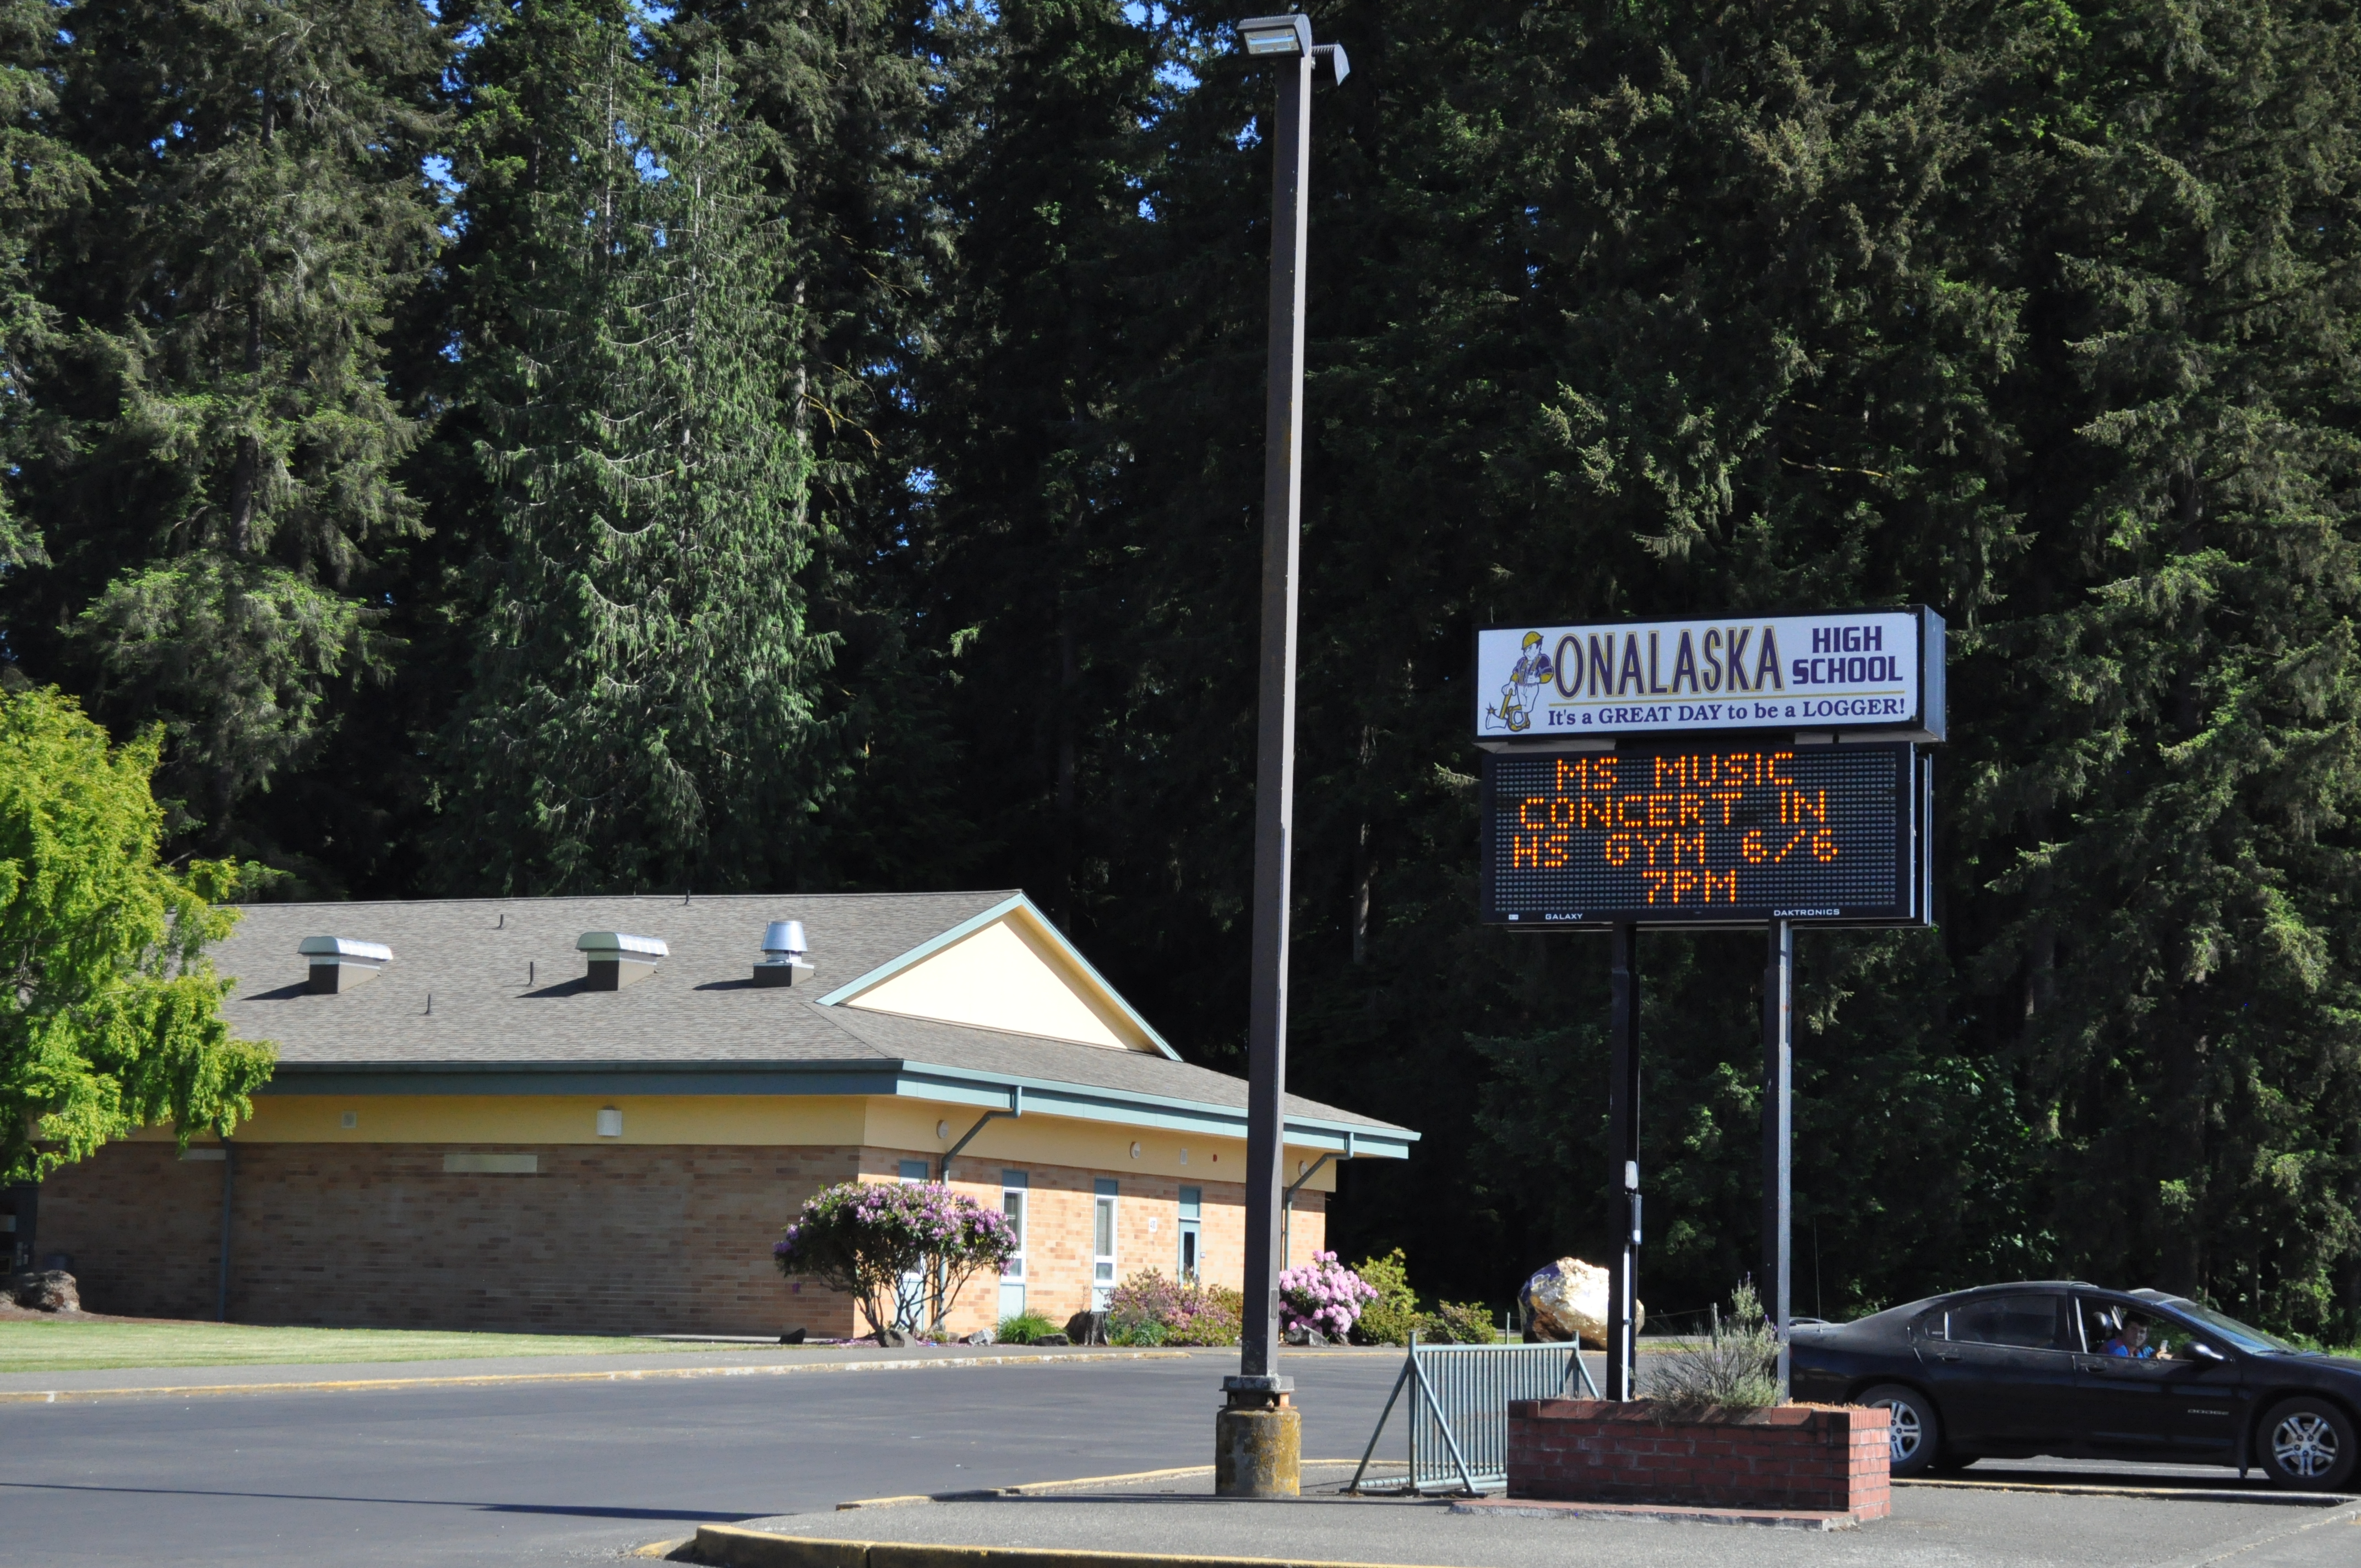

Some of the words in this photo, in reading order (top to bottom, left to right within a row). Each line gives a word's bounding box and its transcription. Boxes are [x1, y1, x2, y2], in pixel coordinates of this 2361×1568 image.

[1812, 625, 1882, 653] HIGH
[1553, 625, 1785, 700] ONALASKA
[1792, 656, 1903, 684] SCHOOL
[1548, 709, 1576, 726] It's
[1582, 713, 1592, 725] a
[1599, 706, 1672, 723] GREAT
[1678, 704, 1722, 721] DAY
[1728, 705, 1748, 720] to
[1755, 703, 1778, 718] be
[1785, 705, 1796, 717] a
[1803, 698, 1905, 716] LOGGER!
[1557, 758, 1618, 791] MS
[1655, 752, 1793, 789] MUSIC
[1520, 792, 1743, 830] CONCERT
[1781, 790, 1825, 824] IN
[1514, 835, 1569, 868] HS
[1606, 831, 1705, 866] GYM
[1743, 829, 1838, 864] 6/6
[1642, 869, 1736, 903] 7PM
